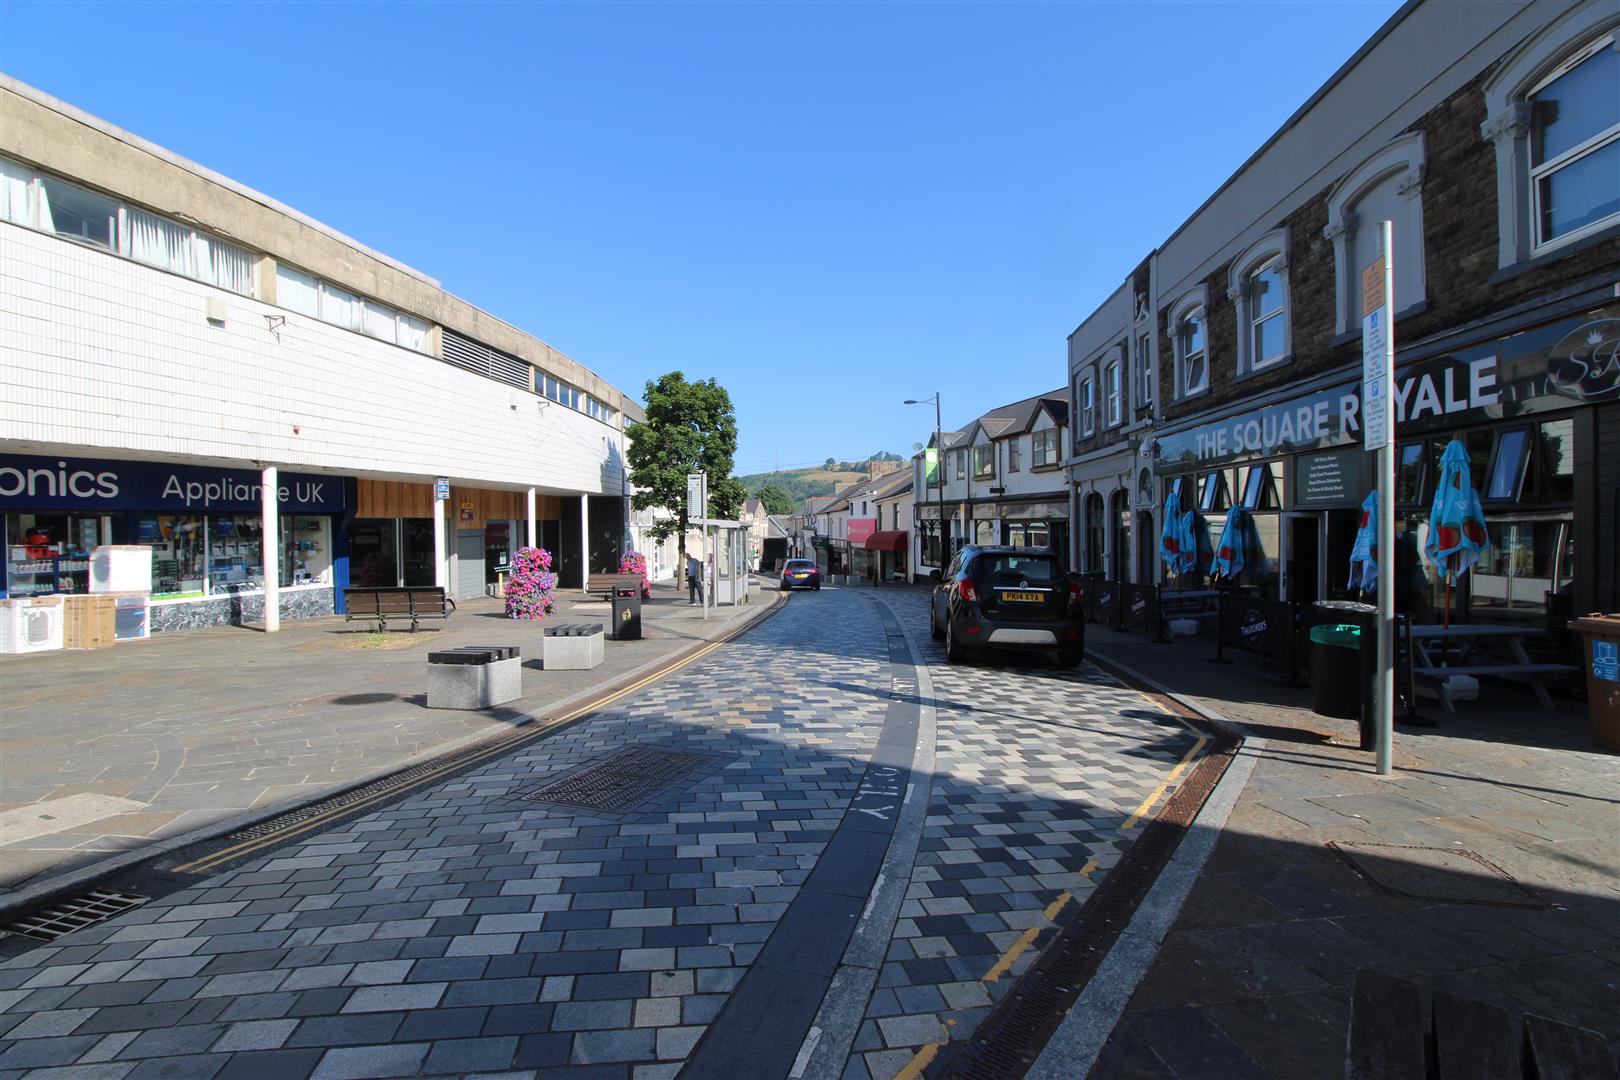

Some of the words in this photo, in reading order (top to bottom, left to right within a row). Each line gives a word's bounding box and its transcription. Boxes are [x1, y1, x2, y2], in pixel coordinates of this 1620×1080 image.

[1195, 427, 1228, 461] THE
[1233, 403, 1329, 455] SQUARE
[1340, 356, 1497, 433] RYALE
[0, 461, 119, 498] onics
[161, 475, 290, 507] Appliane
[296, 482, 325, 504] UK
